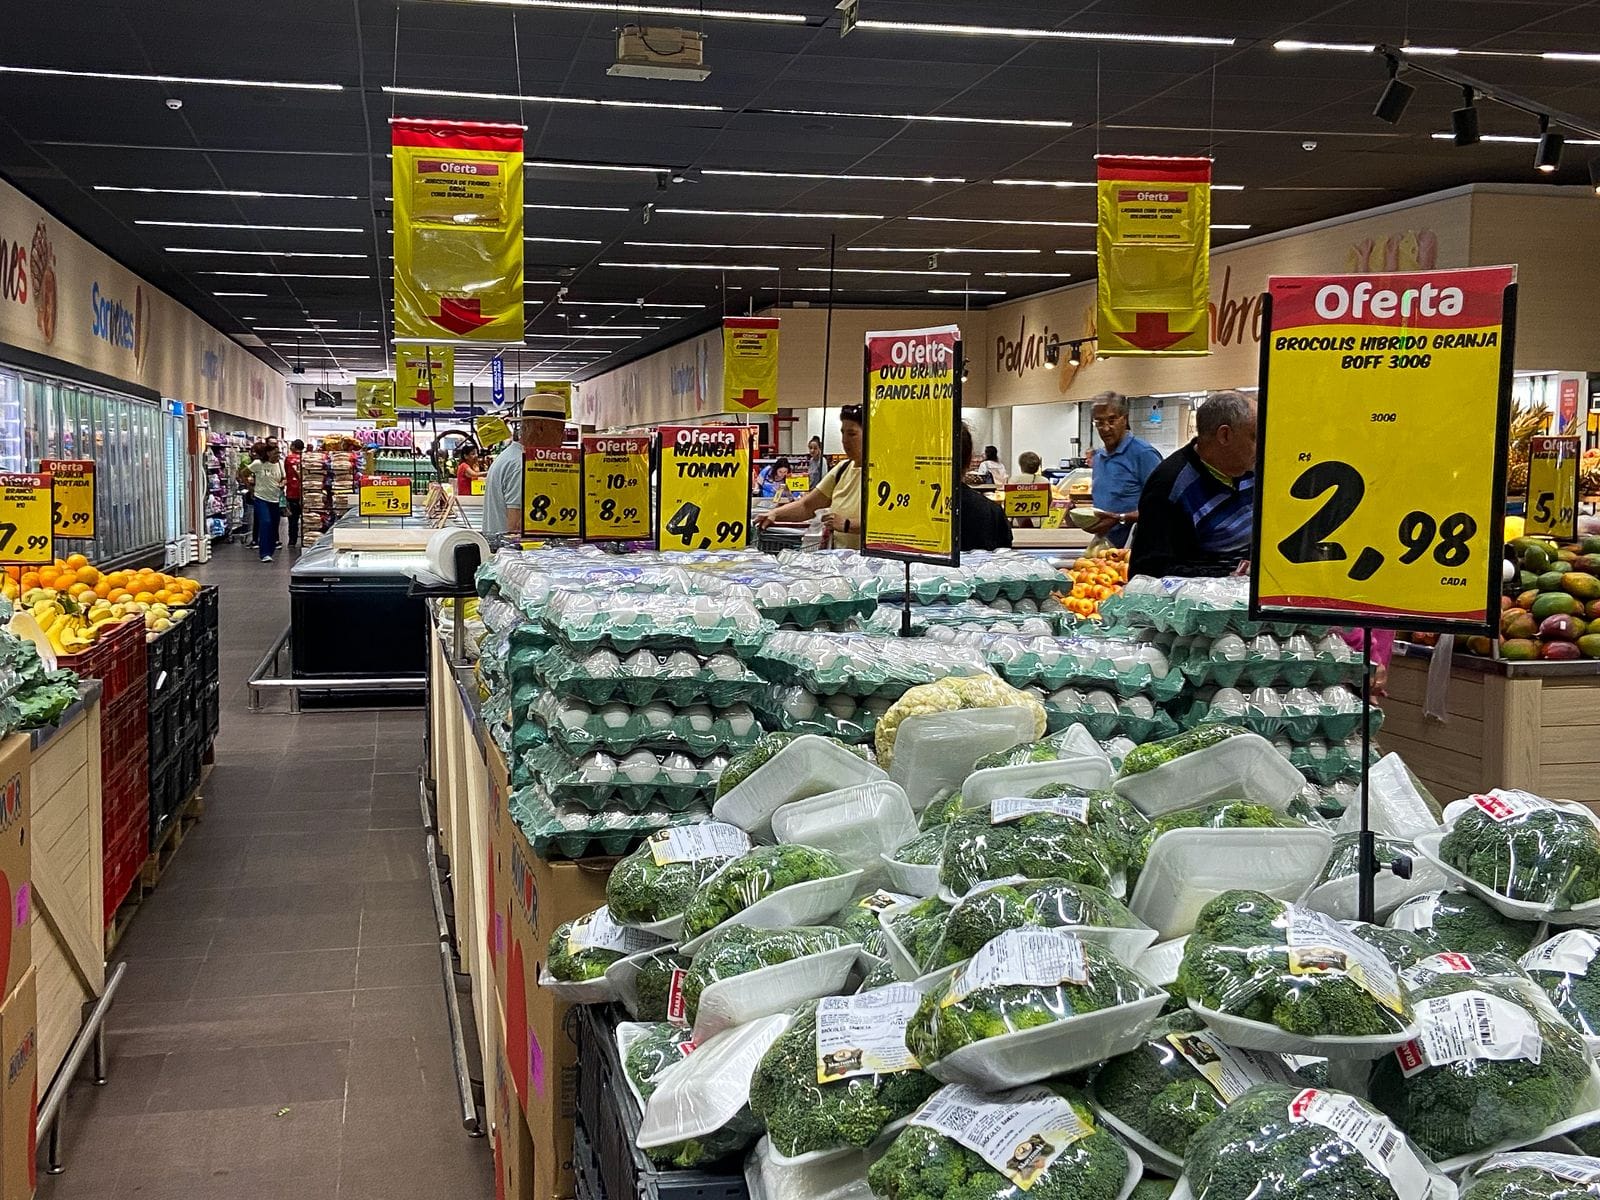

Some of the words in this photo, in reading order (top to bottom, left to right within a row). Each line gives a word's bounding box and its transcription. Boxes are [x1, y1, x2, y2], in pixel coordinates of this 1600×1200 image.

[440, 162, 477, 174] Oferta
[1136, 192, 1169, 201] Oferta
[1314, 281, 1464, 320] Oferta
[1275, 336, 1356, 351] BROCOLIS
[1360, 335, 1428, 351] HIBRIDO
[1432, 332, 1498, 348] GRANJA
[891, 339, 946, 364] Oferta
[1341, 354, 1385, 369] BOFF
[1388, 354, 1432, 368] 300G
[880, 365, 906, 380] OVO
[910, 362, 948, 380] BRANCO
[875, 384, 930, 400] BANDEJA
[1370, 413, 1397, 422] 300G
[677, 429, 735, 445] Oferta
[596, 440, 638, 452] Oferta
[673, 442, 735, 457] MANGA
[536, 449, 573, 460] Oferta
[1298, 452, 1312, 462] R$
[49, 462, 84, 471] Oferta
[676, 462, 741, 478] TOMMY
[0, 475, 41, 487] Oferta
[54, 471, 84, 479] ARANJA
[877, 480, 911, 511] 9,98
[530, 494, 577, 526] 8,99
[599, 498, 637, 524] 8,99
[1014, 501, 1041, 513] 29,19
[666, 502, 744, 550] 4,99
[1277, 460, 1477, 581] 2,98
[0, 523, 48, 554] 7,99
[1440, 577, 1467, 586] CADA
